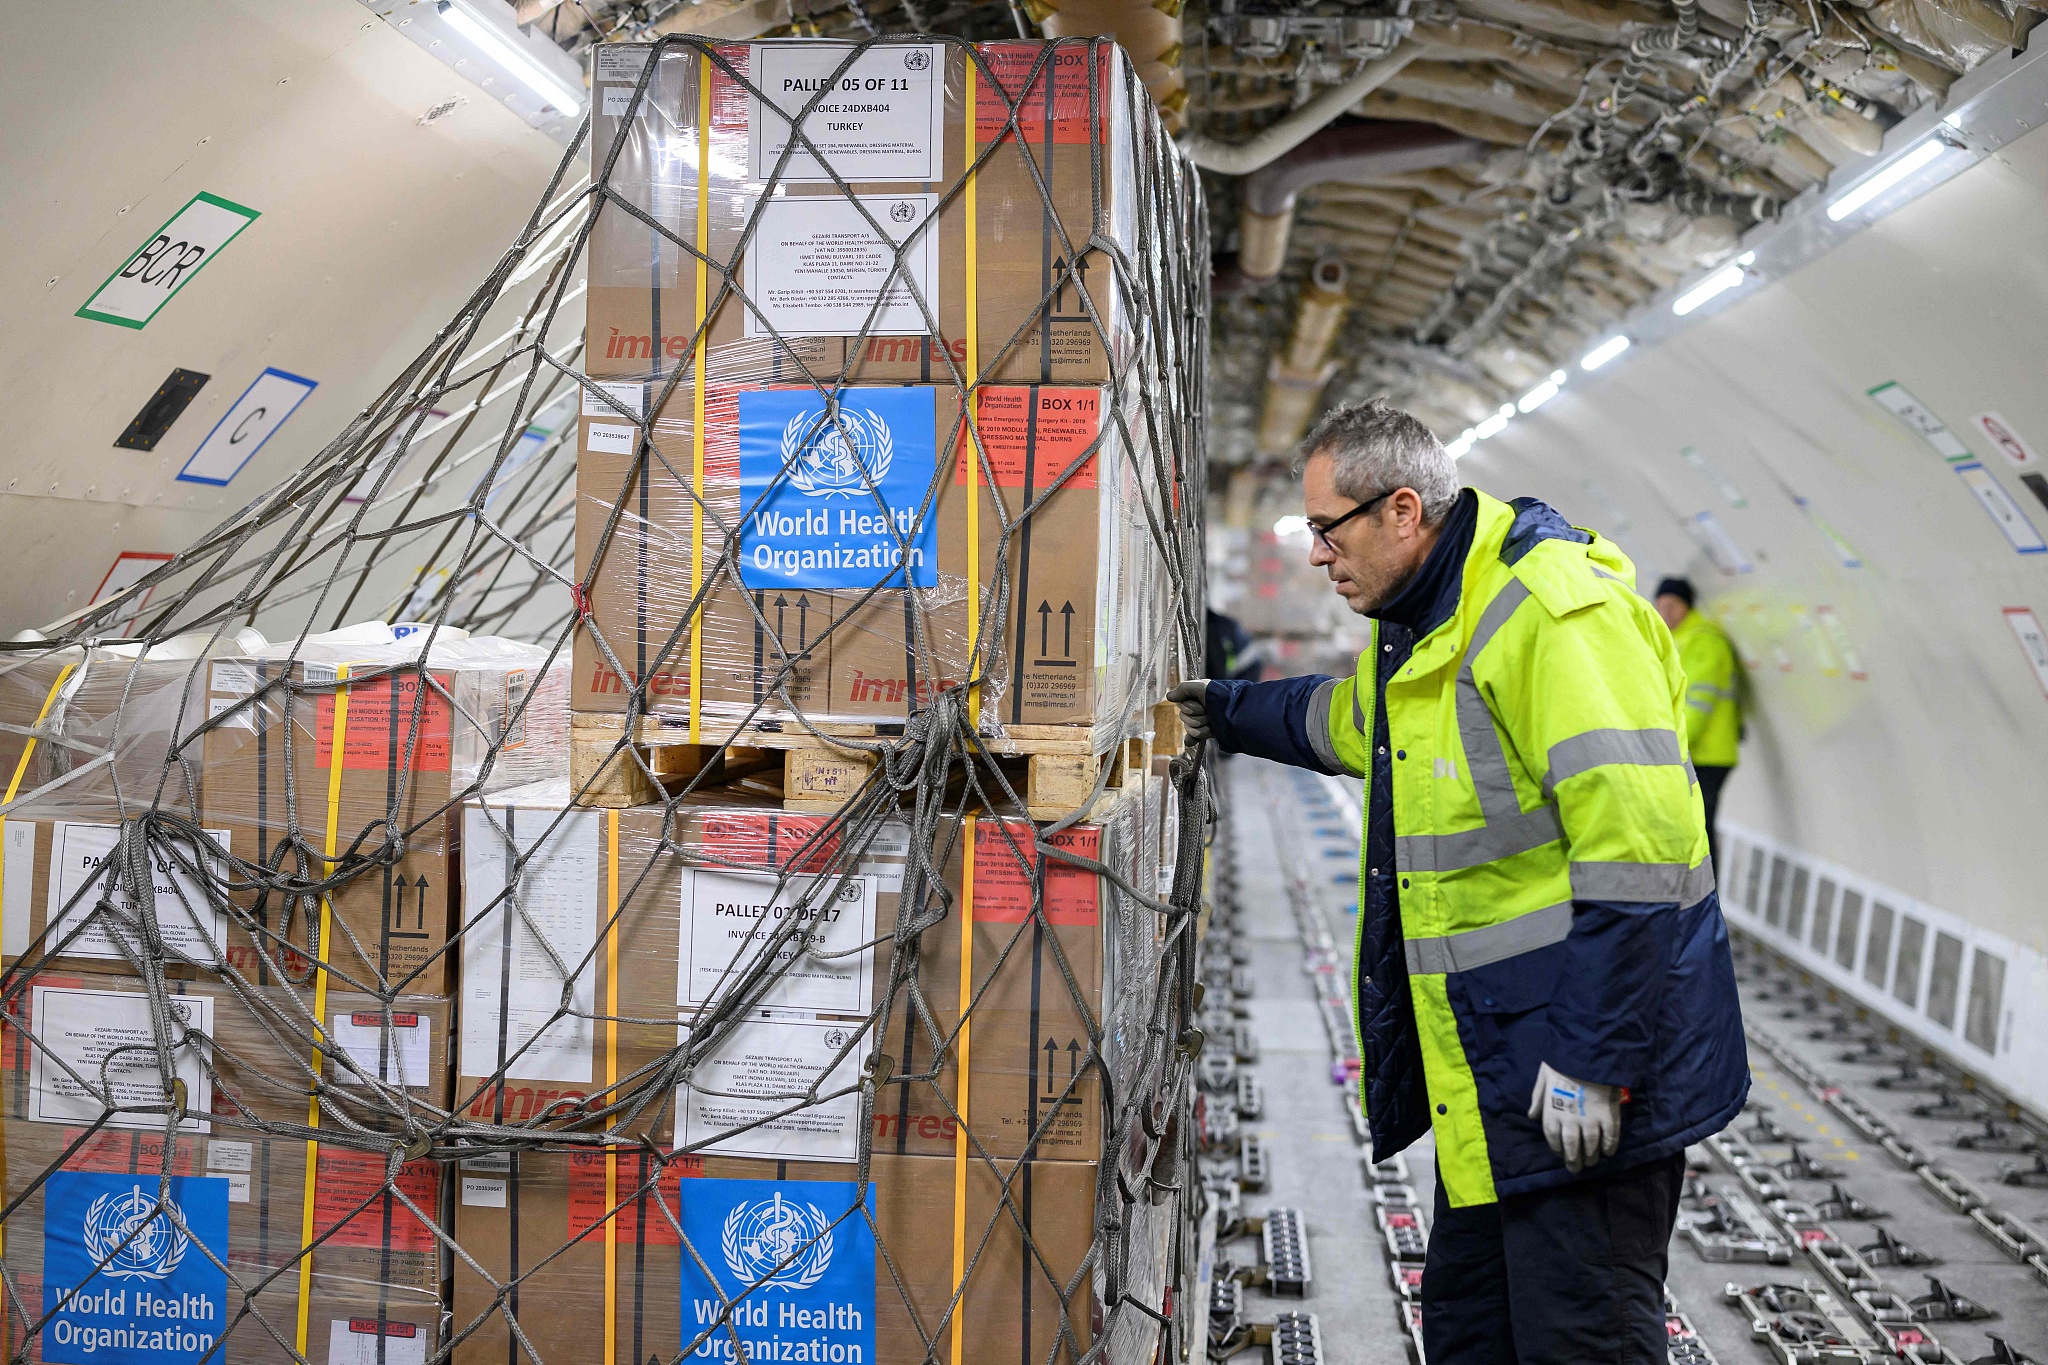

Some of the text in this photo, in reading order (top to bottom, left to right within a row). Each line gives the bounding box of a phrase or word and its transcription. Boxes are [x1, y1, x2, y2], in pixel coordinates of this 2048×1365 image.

[842, 79, 860, 91] 05
[865, 78, 886, 91] OF
[890, 78, 909, 91] 11
[802, 104, 890, 113] IVOICE 24DXB404
[827, 122, 863, 132] TURKEY
[119, 233, 206, 290] BCR
[1003, 395, 1023, 403] Health
[1041, 398, 1095, 411] BOX 1/1
[984, 402, 1022, 410] Organization
[230, 406, 267, 445] C
[993, 416, 1025, 425] Emergency
[753, 506, 924, 537] World Health
[753, 541, 925, 577] Organization
[1031, 672, 1076, 682] Netherlands
[1051, 682, 1076, 691] 296969
[1030, 691, 1076, 700] www.imres.nl
[1023, 700, 1076, 709] imres@imres.nl
[1079, 836, 1097, 847] 1/1
[822, 909, 841, 923] 17
[1001, 1117, 1082, 1128] Tel. 296969
[871, 1112, 957, 1146] mres
[683, 1157, 700, 1169] 1/1
[56, 1287, 127, 1317] World
[135, 1291, 214, 1321] Health
[779, 1302, 862, 1331] Health
[54, 1319, 214, 1353] Organization
